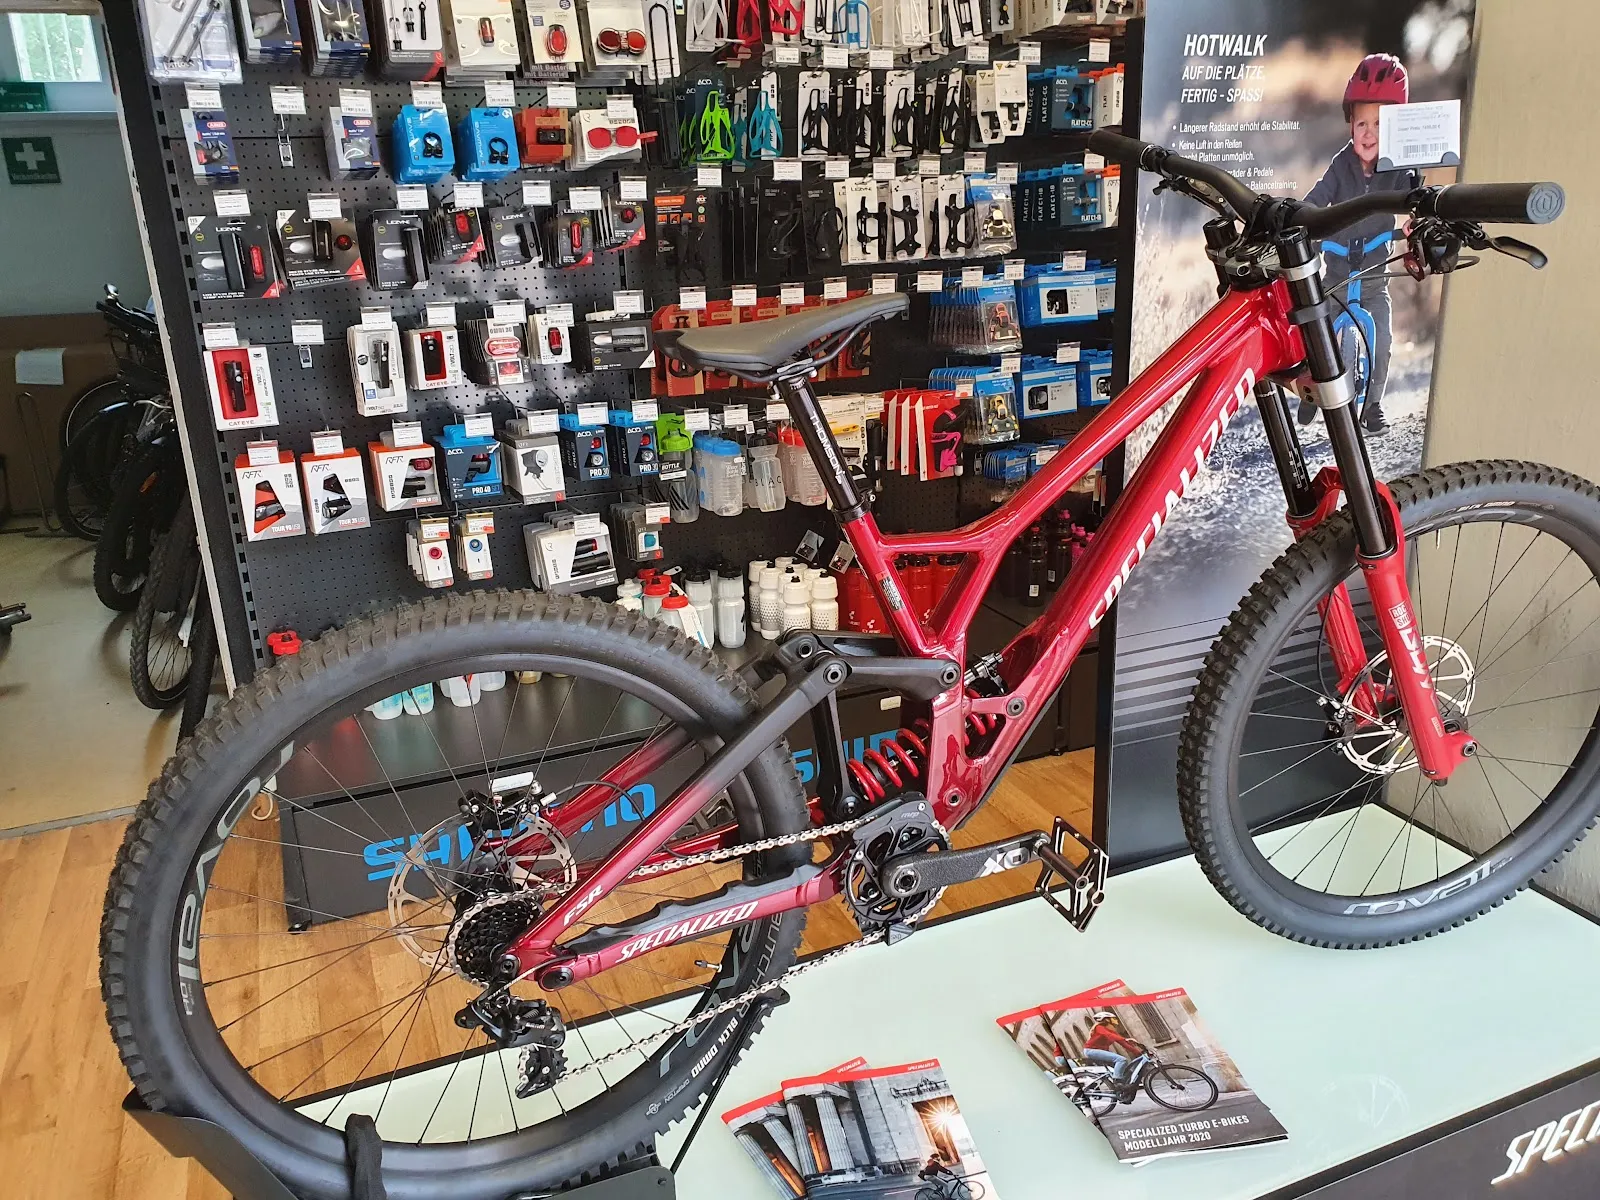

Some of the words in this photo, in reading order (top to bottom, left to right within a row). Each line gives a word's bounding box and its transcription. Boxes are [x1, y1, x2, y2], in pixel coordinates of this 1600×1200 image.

[1183, 34, 1267, 57] HOTWALK
[1182, 65, 1204, 81] AUF
[1205, 65, 1223, 80] DIE
[1224, 63, 1266, 81] PLÄTZE,
[1181, 89, 1217, 103] FERTIG
[1226, 88, 1264, 103] SPASS!
[1179, 122, 1208, 134] Längerer
[1209, 121, 1239, 132] Radstand
[1260, 121, 1271, 131] die
[1179, 140, 1196, 150] Keine
[1196, 140, 1207, 149] Luft
[1207, 140, 1212, 149] in
[1213, 140, 1224, 149] den
[1224, 139, 1243, 149] Reifen
[1198, 152, 1222, 162] Platten
[1221, 150, 1255, 163] unmöglich.
[1246, 167, 1252, 177] &
[1253, 168, 1274, 177] Pedale
[1250, 181, 1298, 191] Balancetraining.
[810, 411, 843, 480] THOMSON
[589, 468, 602, 477] PRO
[602, 467, 610, 476] 30
[639, 464, 652, 472] PRO
[472, 486, 484, 495] PRO
[563, 885, 604, 927] FSR
[615, 901, 760, 964] SPECIALIZED
[1118, 1123, 1178, 1141] SPECIALIZED
[1178, 1119, 1211, 1132] TURBO
[1213, 1115, 1250, 1129] E-BIKES
[1124, 1134, 1188, 1152] MODELLJAHR
[1189, 1131, 1211, 1144] 2020
